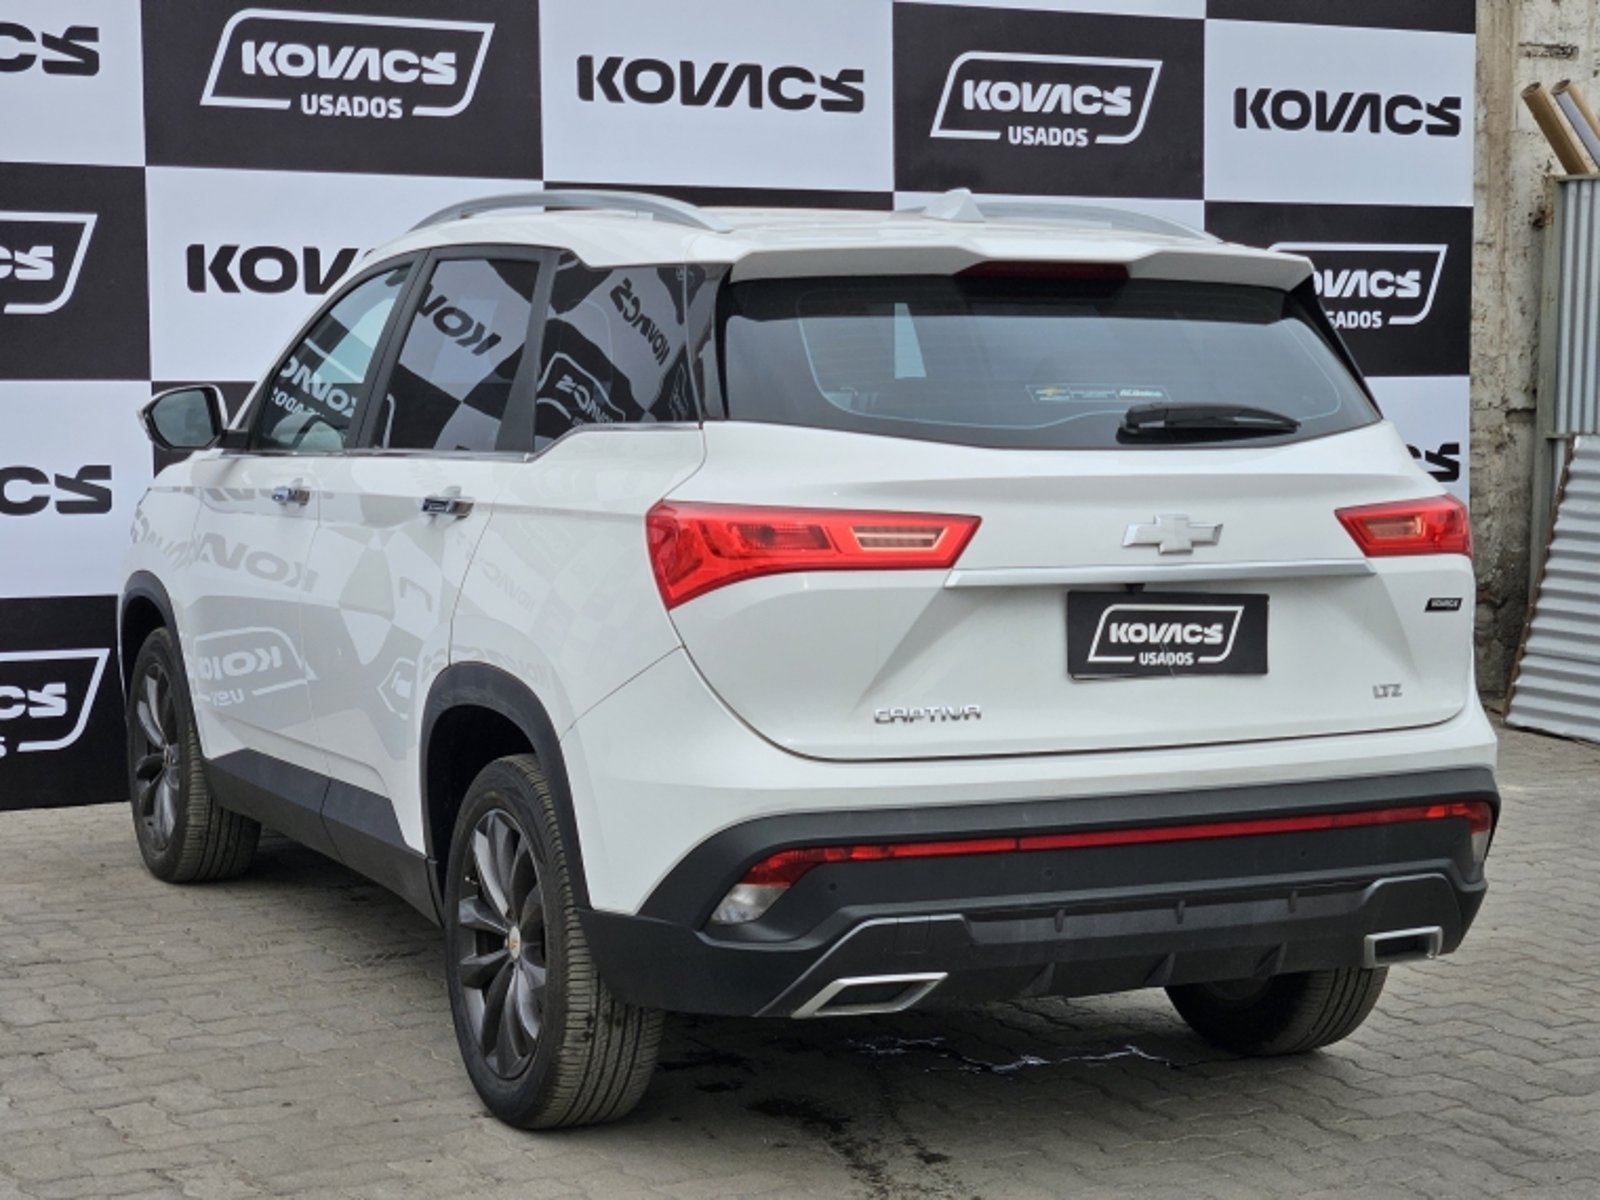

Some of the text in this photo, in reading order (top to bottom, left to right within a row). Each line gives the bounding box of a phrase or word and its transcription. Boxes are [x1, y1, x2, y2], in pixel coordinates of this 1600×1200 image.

[241, 40, 457, 86] KOVACS
[577, 55, 864, 113] KOVACS
[300, 93, 403, 119] USADOS
[963, 79, 1132, 117] KOVACS
[1234, 87, 1462, 137] KOVACS
[1008, 125, 1088, 147] USADOS
[186, 244, 375, 294] KOV
[1109, 622, 1224, 645] KOVACS
[1138, 651, 1195, 666] USADOS
[1372, 683, 1403, 700] LTZ
[874, 705, 982, 724] CAPTIVA
